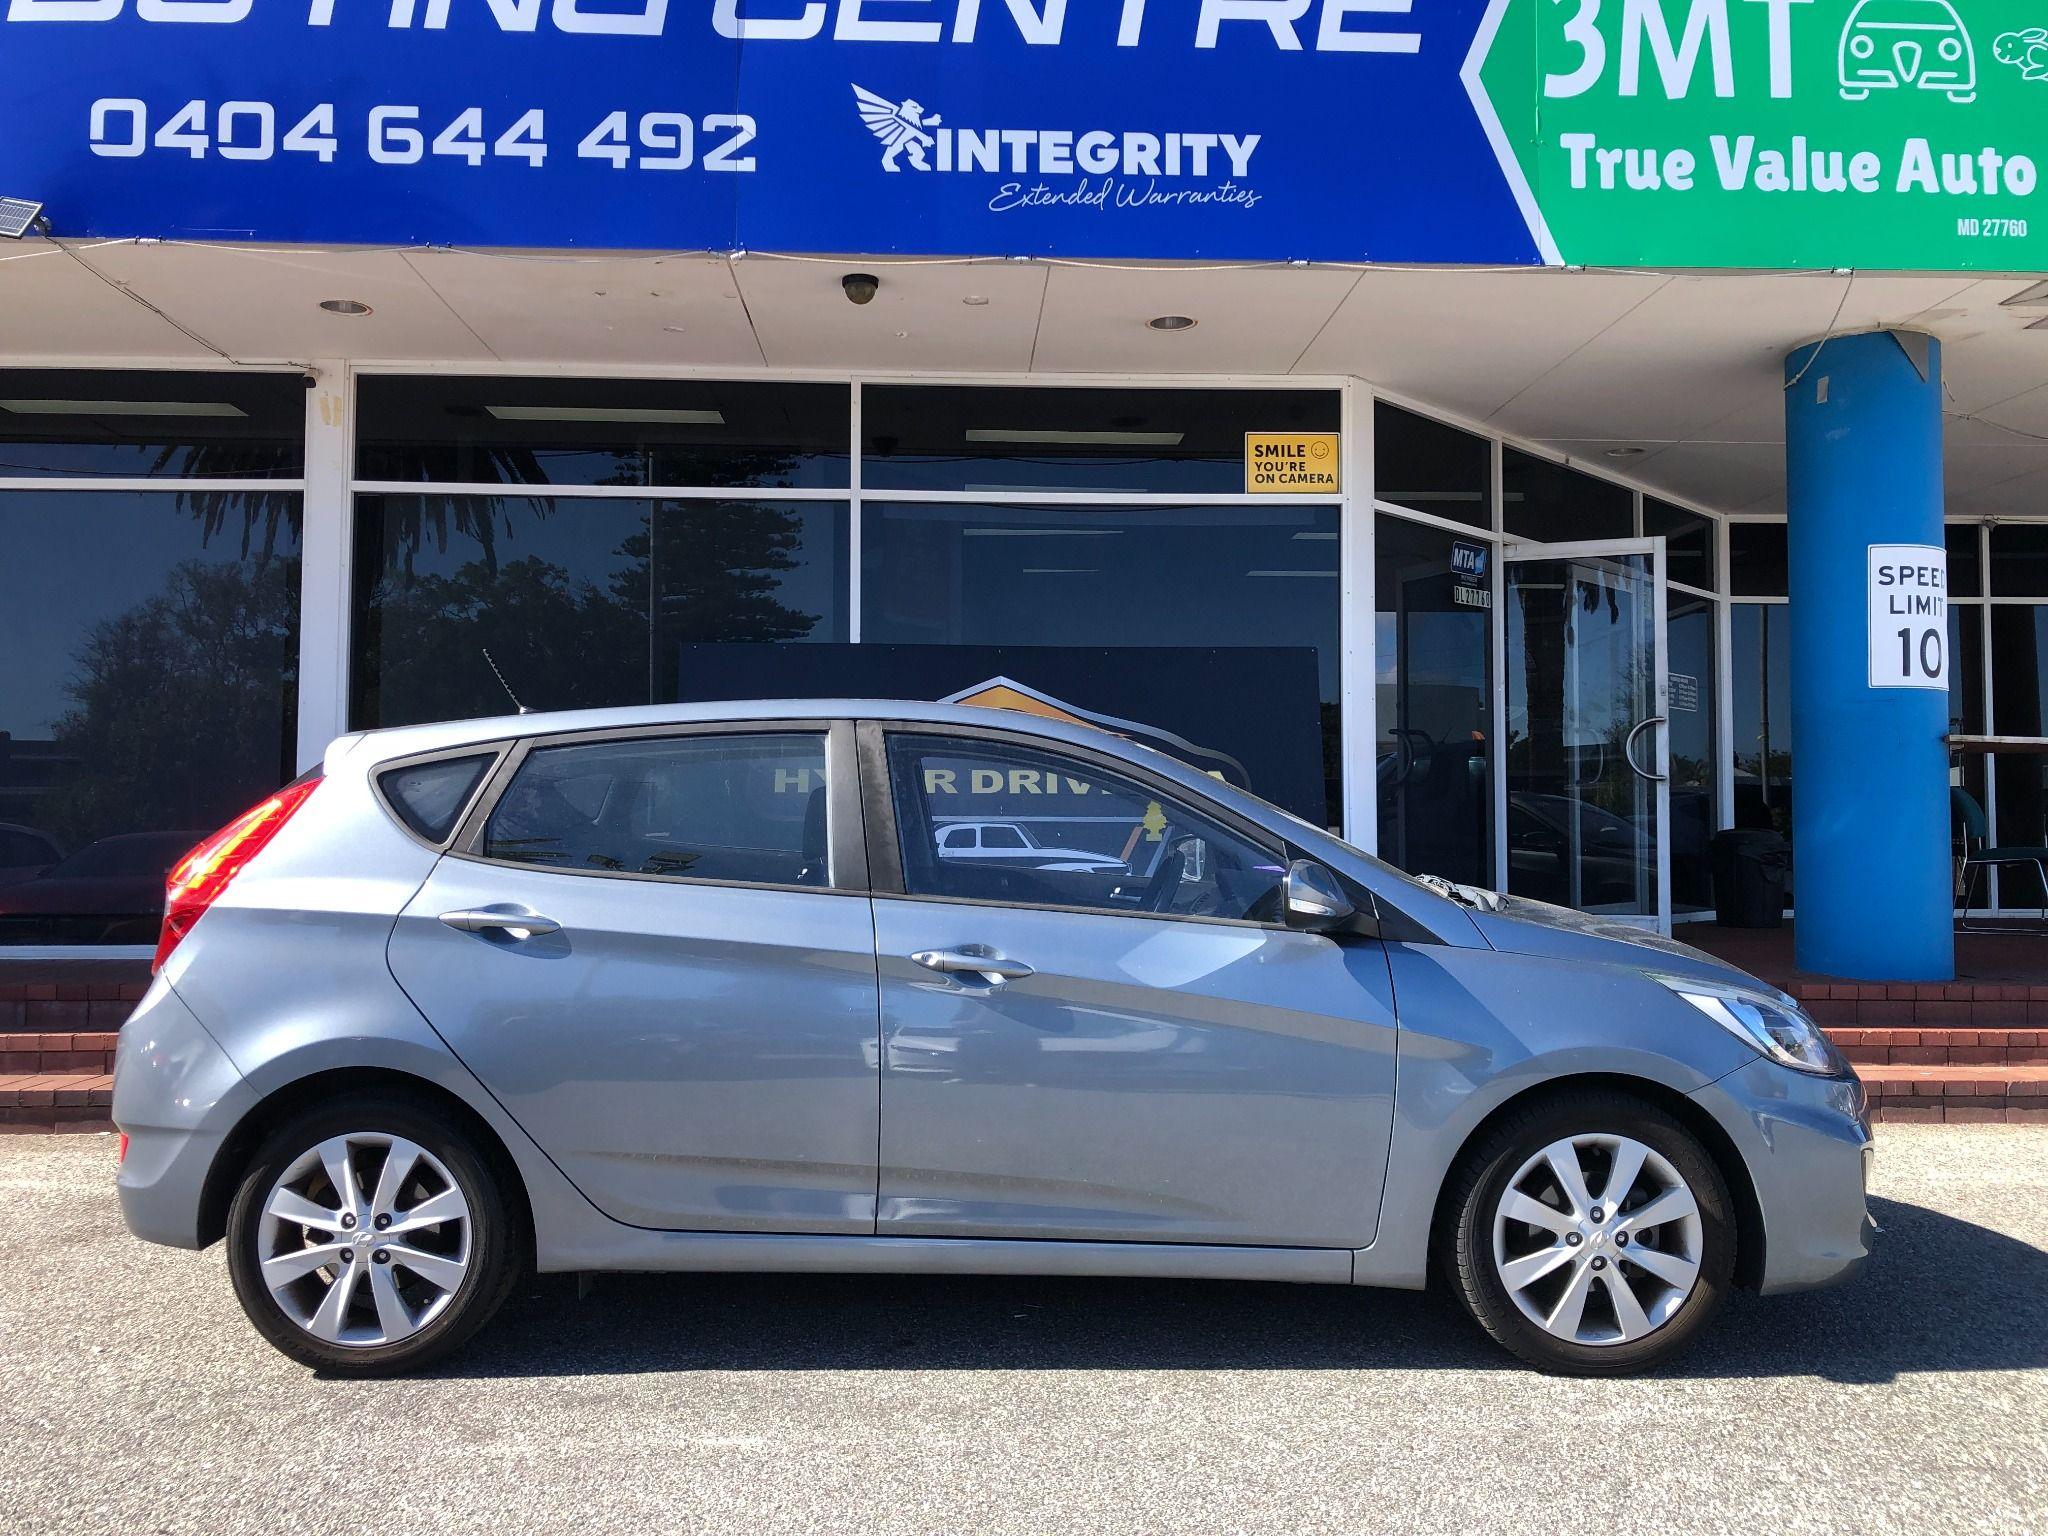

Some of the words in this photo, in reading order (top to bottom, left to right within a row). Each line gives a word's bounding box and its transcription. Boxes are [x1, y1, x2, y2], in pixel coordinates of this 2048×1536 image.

[1543, 0, 1812, 99] 3MT
[90, 97, 337, 163] 0404
[368, 105, 548, 167] 644
[577, 110, 757, 172] 492
[935, 128, 1262, 177] INTEGRITY
[1560, 132, 1695, 190] True
[1708, 135, 1881, 193] Value
[1895, 138, 2037, 196] Auto
[989, 177, 1113, 212] Extended
[1115, 178, 1263, 210] Warranties
[1957, 218, 1980, 236] MD
[1982, 219, 2028, 237] 27760
[1254, 444, 1306, 458] SMILE
[1254, 461, 1306, 472] YOU'RE
[1254, 473, 1275, 484] ON
[1278, 473, 1334, 484] CAMERA
[1453, 547, 1475, 570] MTA
[1889, 595, 1944, 617] LIMIT
[1897, 627, 1942, 679] 10
